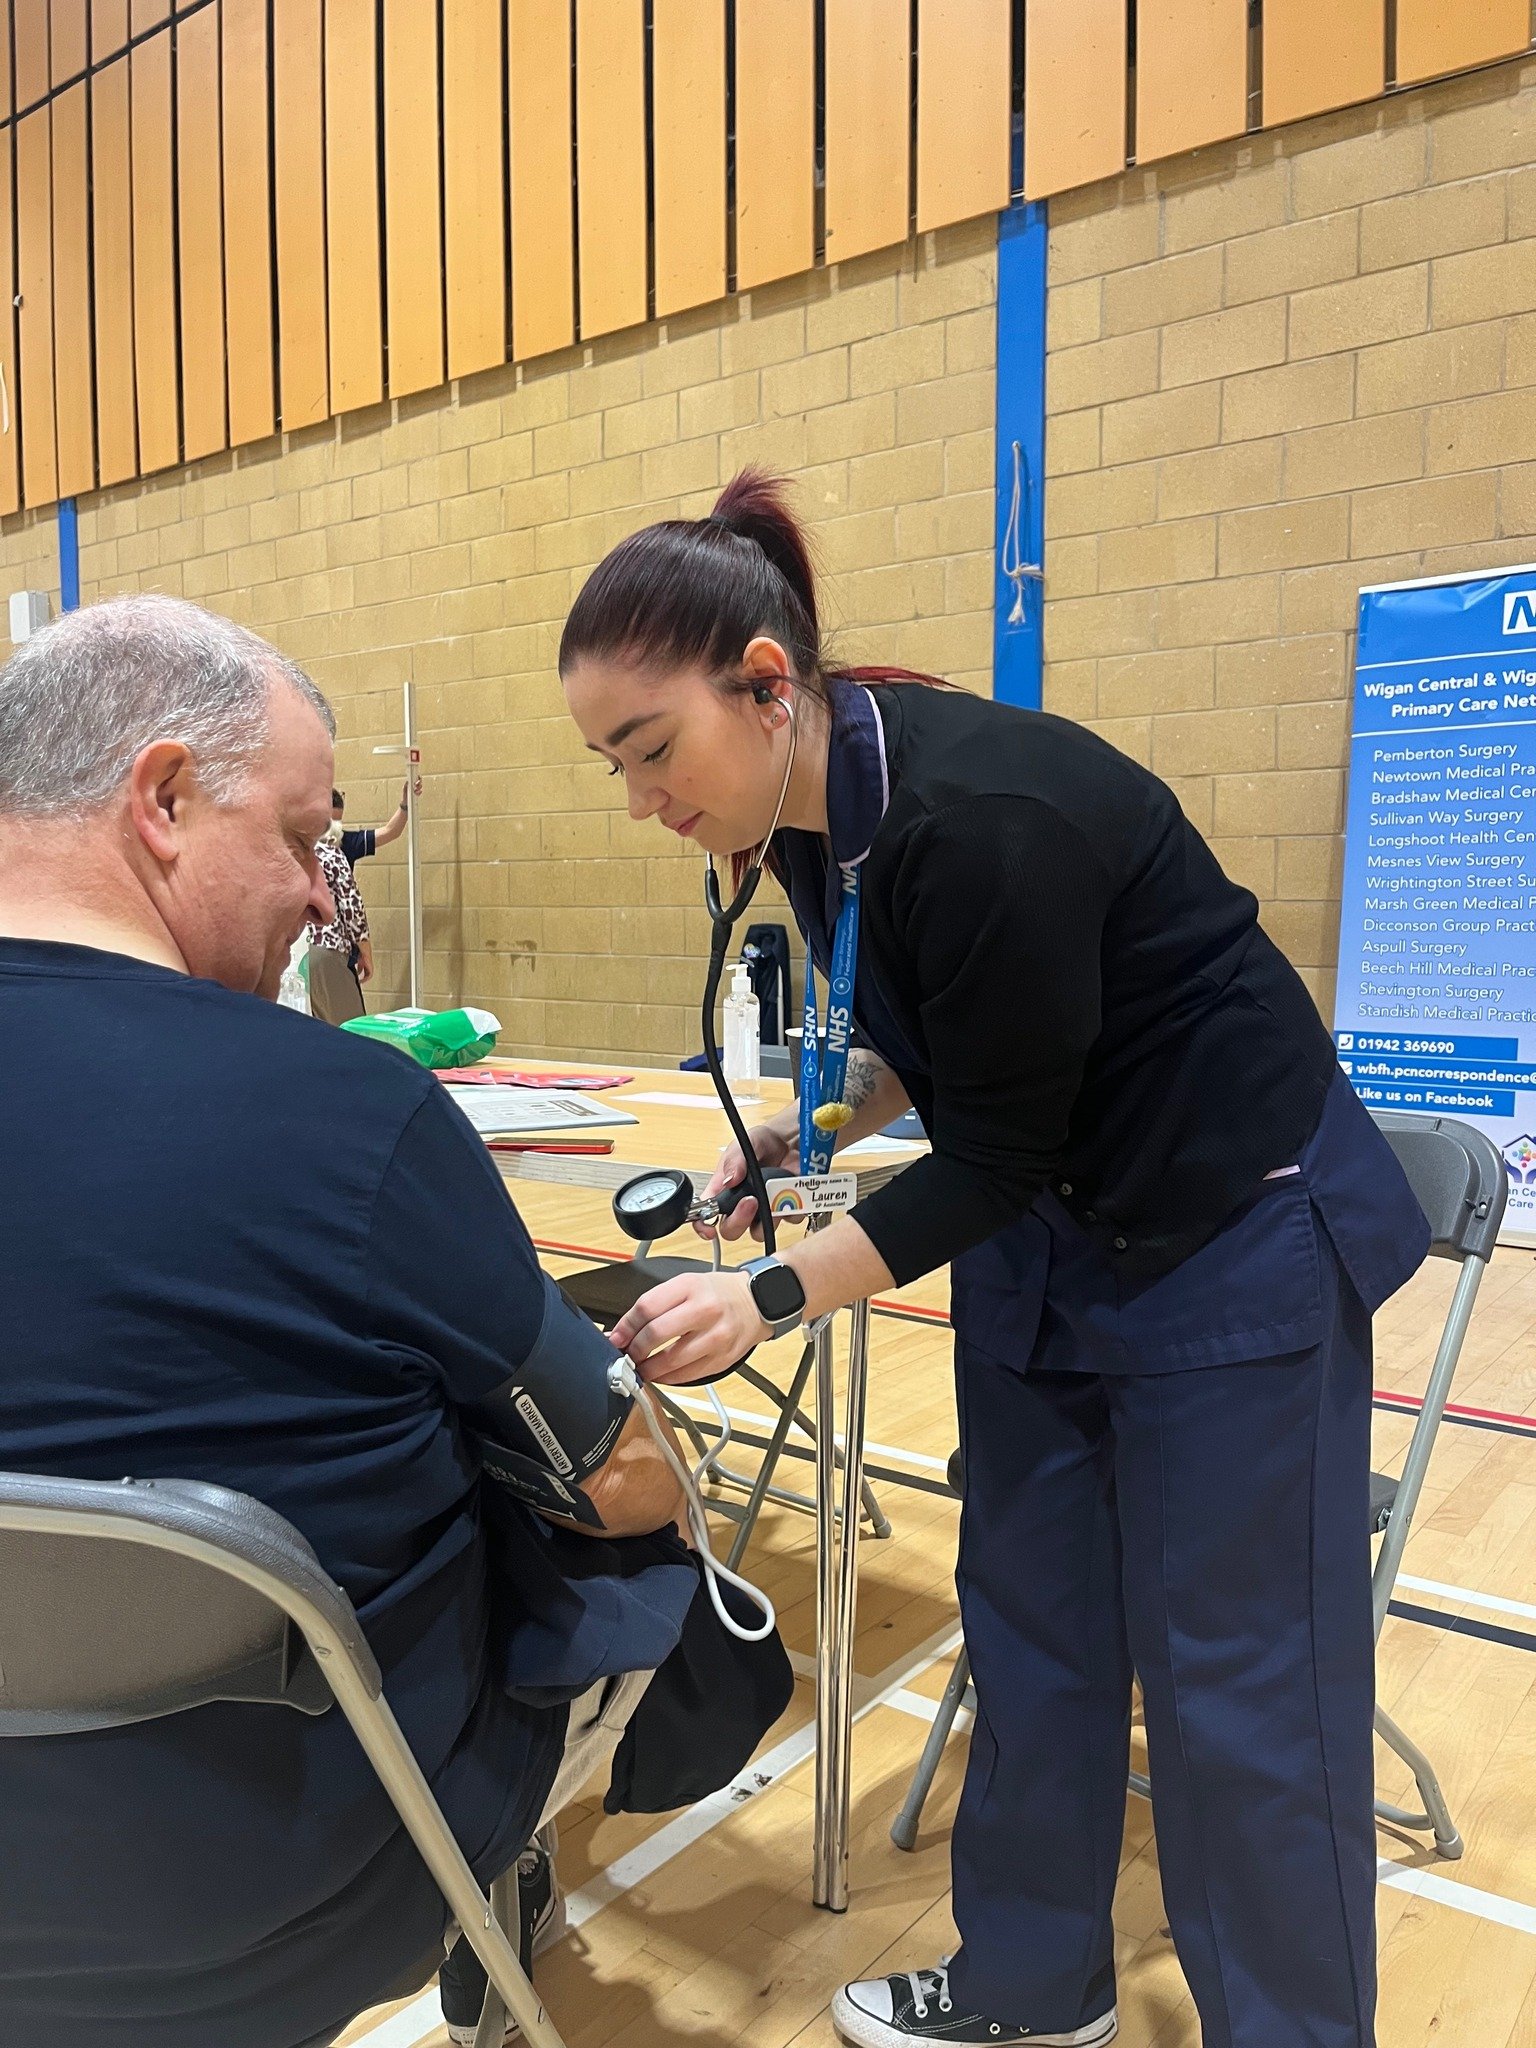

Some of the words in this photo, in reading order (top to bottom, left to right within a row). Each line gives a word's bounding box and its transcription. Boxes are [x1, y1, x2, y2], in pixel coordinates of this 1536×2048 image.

[1364, 682, 1413, 698] Wigan
[1418, 673, 1478, 692] Central
[1483, 672, 1497, 686] &
[1392, 702, 1454, 717] Primary
[1459, 698, 1498, 712] Care
[1374, 748, 1454, 762] Pemberton
[1459, 744, 1518, 759] Surgery
[1373, 771, 1441, 783] Newtown
[1446, 764, 1505, 779] Medical
[1371, 792, 1440, 805] Bradshaw
[1445, 785, 1504, 801] Medical
[1370, 813, 1423, 826] Sullivan
[1428, 811, 1459, 826] Way
[1464, 809, 1524, 825] Surgery
[1369, 834, 1445, 849] Longshoot
[1450, 830, 1498, 844] Health
[1504, 829, 1536, 843] Cen
[1367, 855, 1421, 867] Mesnes
[1426, 854, 1461, 867] View
[1466, 853, 1525, 869] Surgery
[1366, 876, 1461, 892] Wrightington
[1466, 875, 1512, 888] Street
[1365, 897, 1408, 910] Marsh
[1413, 897, 1458, 910] Green
[1463, 896, 1523, 910] Medical
[1363, 919, 1437, 932] Dicconson
[1442, 919, 1491, 935] Group
[1362, 940, 1406, 955] Aspull
[1411, 940, 1467, 957] Surgery
[1361, 961, 1404, 974] Beech
[1409, 962, 1432, 975] Hill
[1437, 962, 1497, 976] Medical
[1360, 982, 1440, 999] Shevington
[1445, 984, 1503, 1001] Surgery
[1358, 1003, 1419, 1018] Standish
[1424, 1005, 1482, 1021] Medical
[804, 1006, 816, 1051] NHS
[828, 1006, 849, 1053] NHS
[1358, 1038, 1400, 1051] 01942
[1403, 1040, 1454, 1054] 369690
[1356, 1087, 1382, 1099] Like
[1386, 1092, 1401, 1101] us
[1405, 1093, 1421, 1102] on
[1426, 1091, 1493, 1107] Facebook
[812, 1191, 847, 1201] Lauren
[1508, 1198, 1534, 1209] Care
[520, 1399, 544, 1430] MARKER
[538, 1427, 554, 1448] INDEX
[549, 1447, 569, 1470] ARTERY
